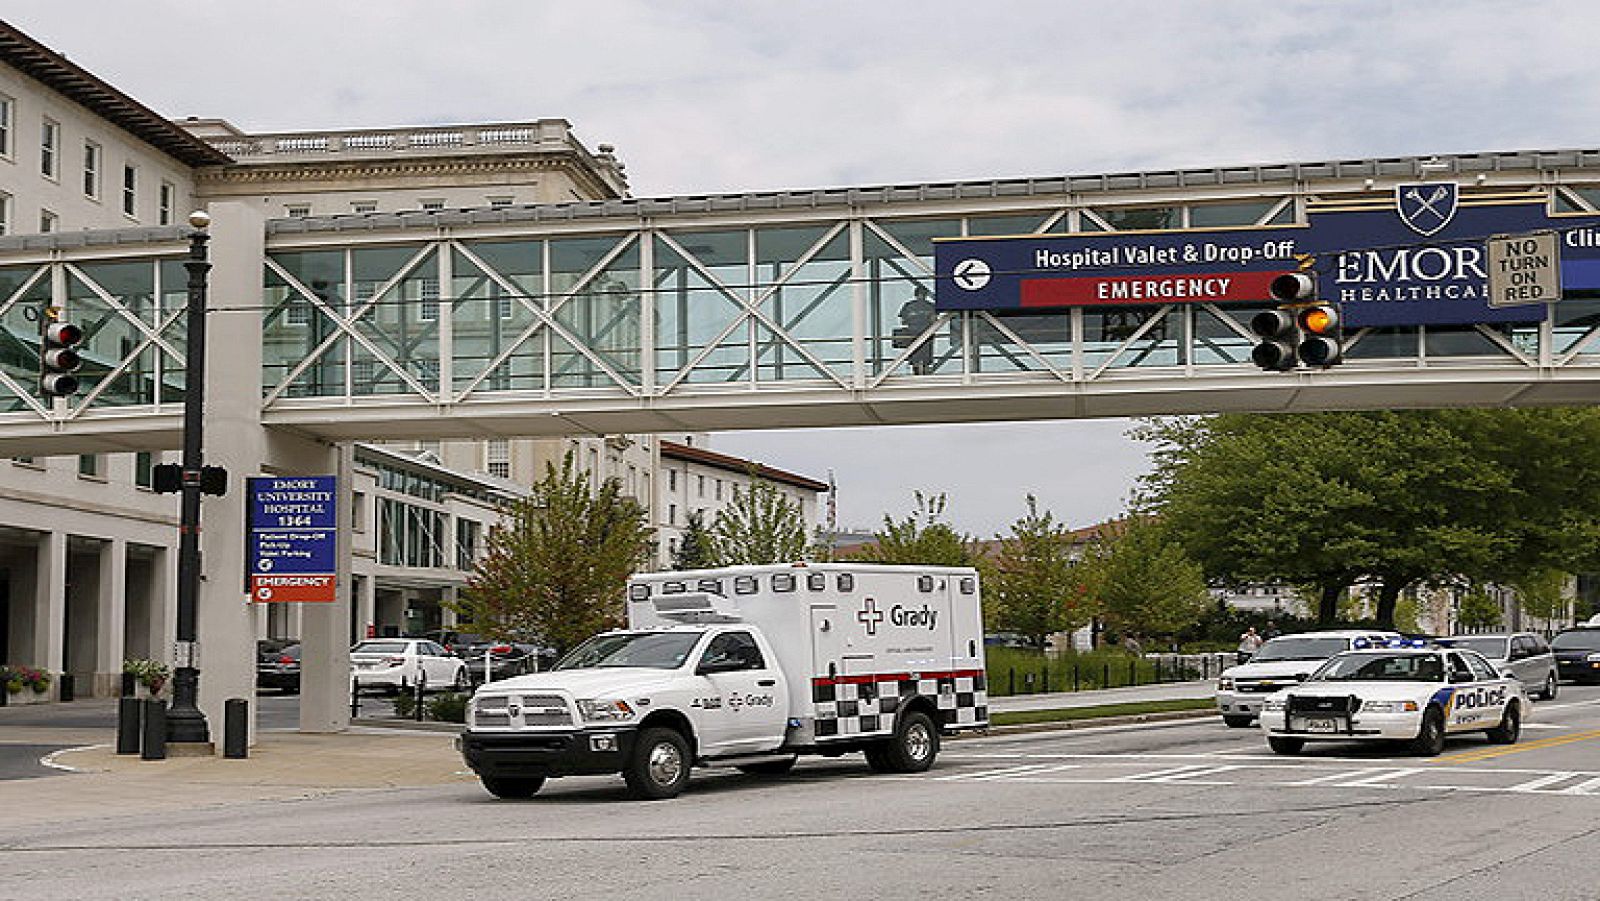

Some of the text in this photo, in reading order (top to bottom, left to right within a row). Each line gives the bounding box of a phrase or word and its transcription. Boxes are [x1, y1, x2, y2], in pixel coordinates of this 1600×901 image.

[1036, 240, 1295, 269] Hospital Valet & Drop-Off
[1506, 239, 1538, 256] NO
[1335, 247, 1488, 284] EMOR
[1500, 256, 1549, 272] TURN
[1512, 271, 1536, 286] ON
[1097, 279, 1231, 299] EMERGENCY
[1505, 285, 1542, 301] RED
[273, 479, 318, 489] EMORY
[257, 492, 333, 502] UNIVERSITY
[264, 504, 326, 514] HOSPITAL
[278, 516, 311, 527] 1364
[256, 576, 330, 587] EMERGENCY
[891, 605, 937, 630] Grady
[745, 694, 774, 708] Grady
[1455, 686, 1507, 710] POLICE
